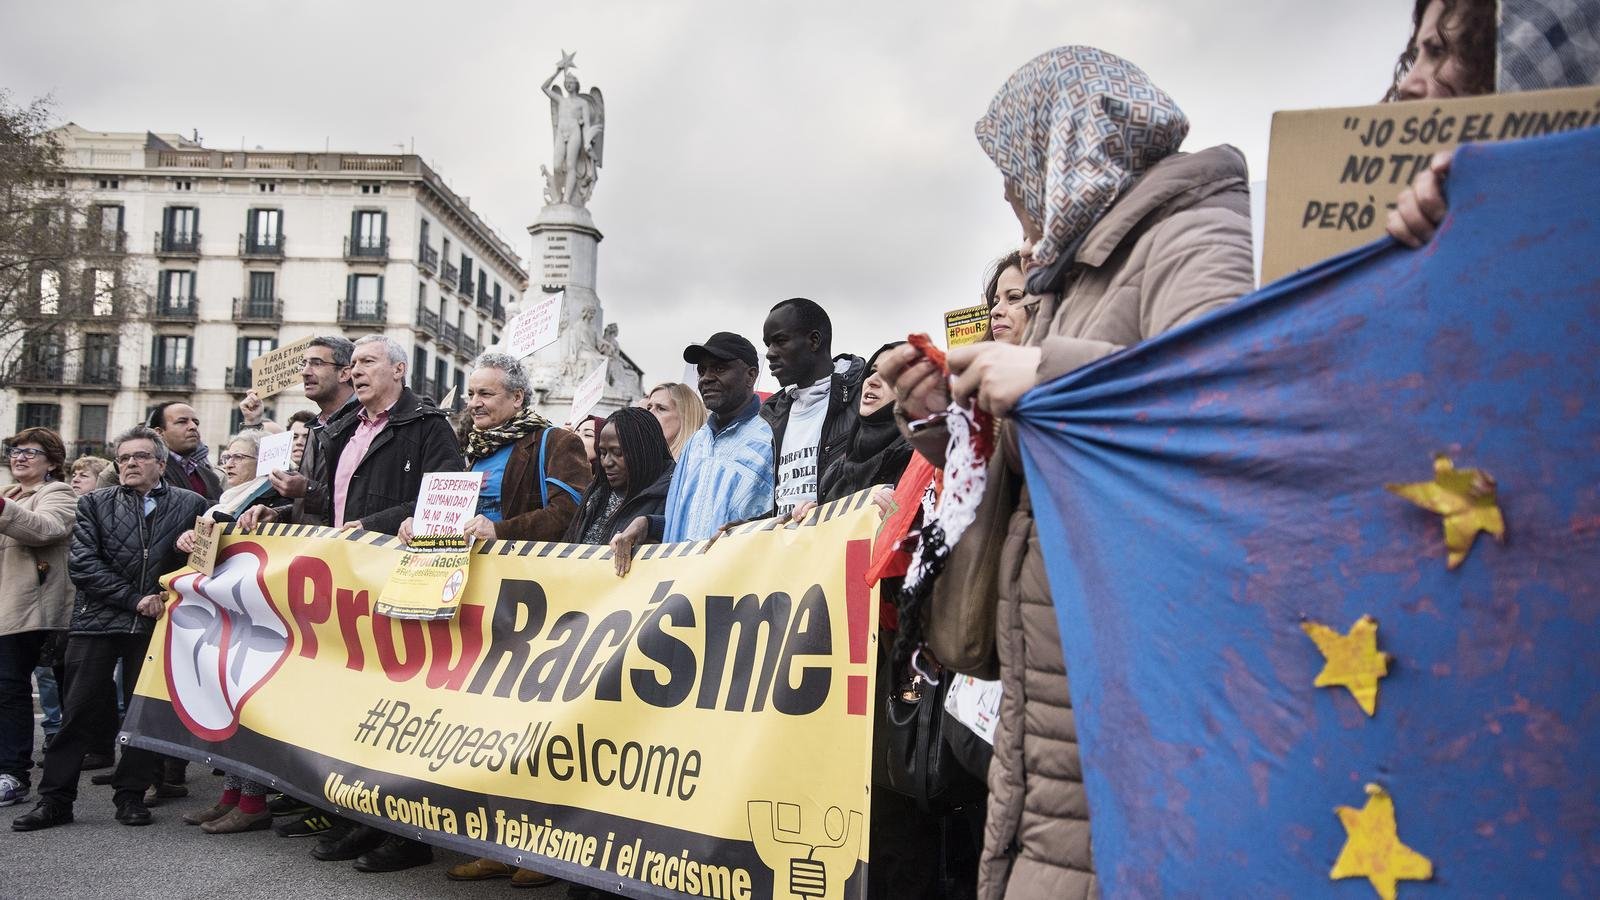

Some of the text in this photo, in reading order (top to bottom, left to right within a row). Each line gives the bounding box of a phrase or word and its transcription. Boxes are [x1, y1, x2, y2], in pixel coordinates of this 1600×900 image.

[1399, 108, 1454, 145] SÓC
[1457, 112, 1494, 142] EL
[1340, 155, 1383, 184] NO
[1302, 195, 1376, 231] PERÒ
[264, 365, 273, 375] TU
[267, 384, 274, 393] EL
[422, 508, 462, 524] YA NO HAY
[425, 523, 458, 535] TIEMPO
[354, 698, 702, 801] #RefugeesWelcome
[323, 772, 752, 900] Unitat contra el feixisme i el racisme
